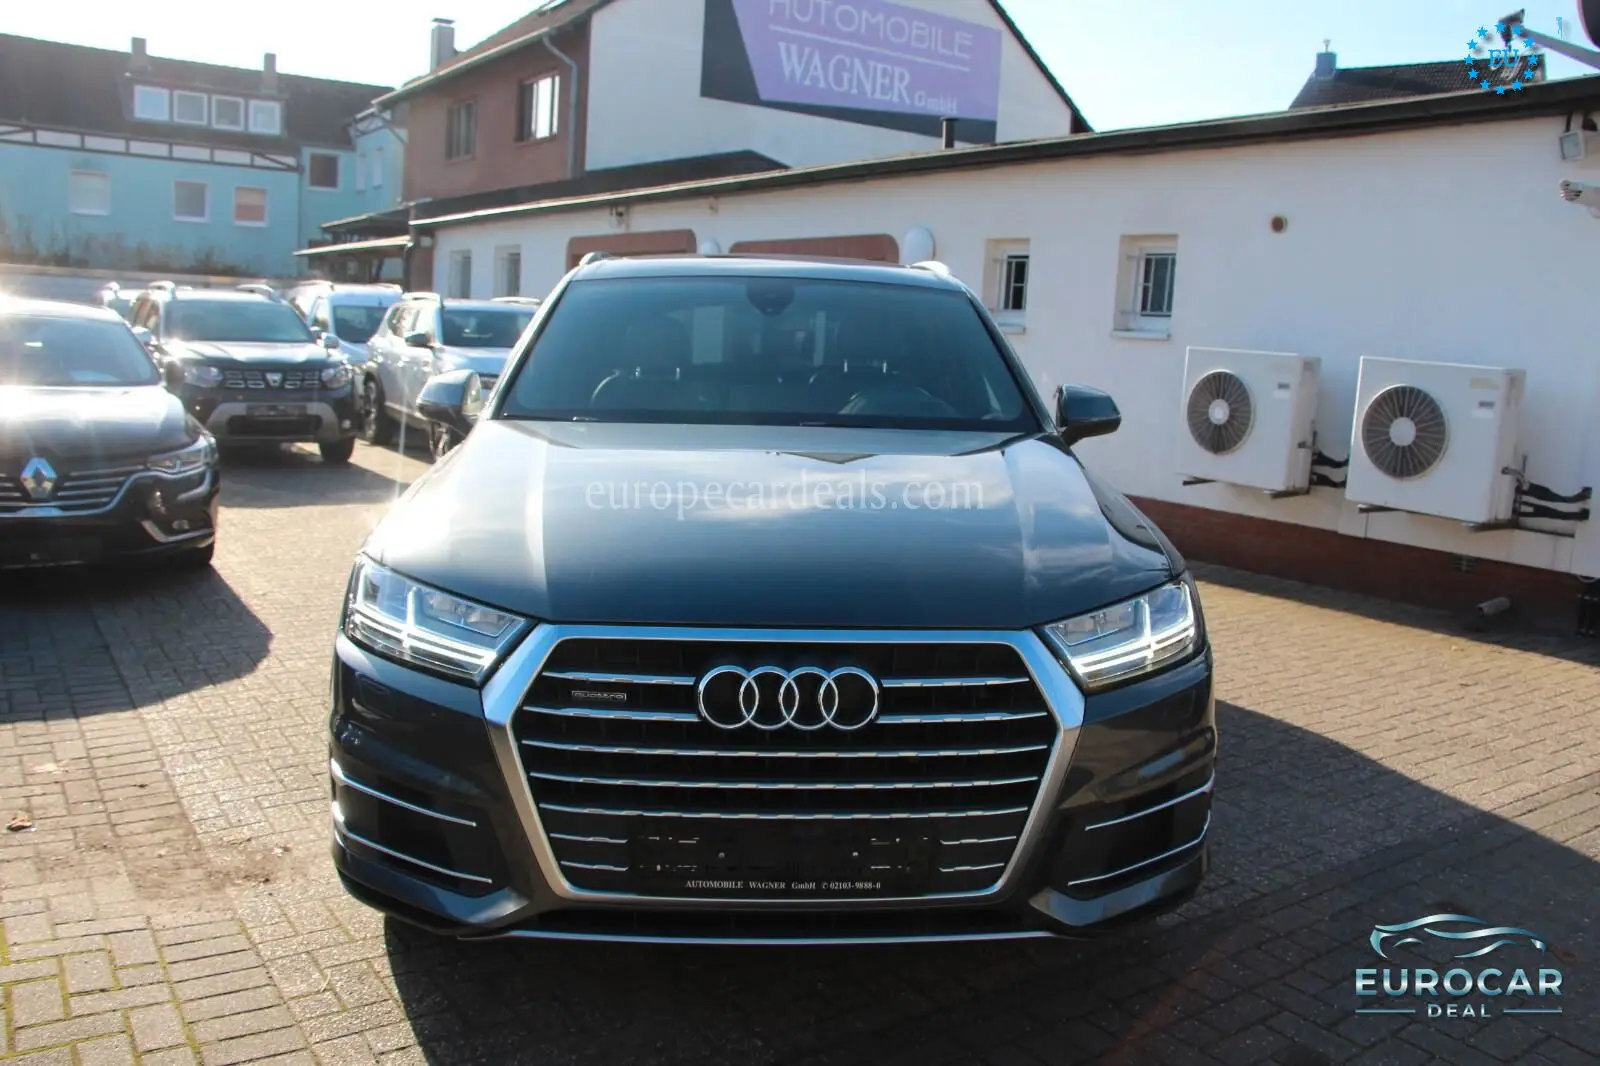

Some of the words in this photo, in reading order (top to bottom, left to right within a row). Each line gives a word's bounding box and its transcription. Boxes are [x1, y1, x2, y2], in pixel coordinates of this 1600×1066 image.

[768, 0, 974, 59] AUTOMOBILE
[778, 42, 910, 104] WAGNER
[685, 880, 744, 889] AUTOMOBILE
[749, 881, 786, 889] WAGNER
[791, 881, 816, 889] GmbH
